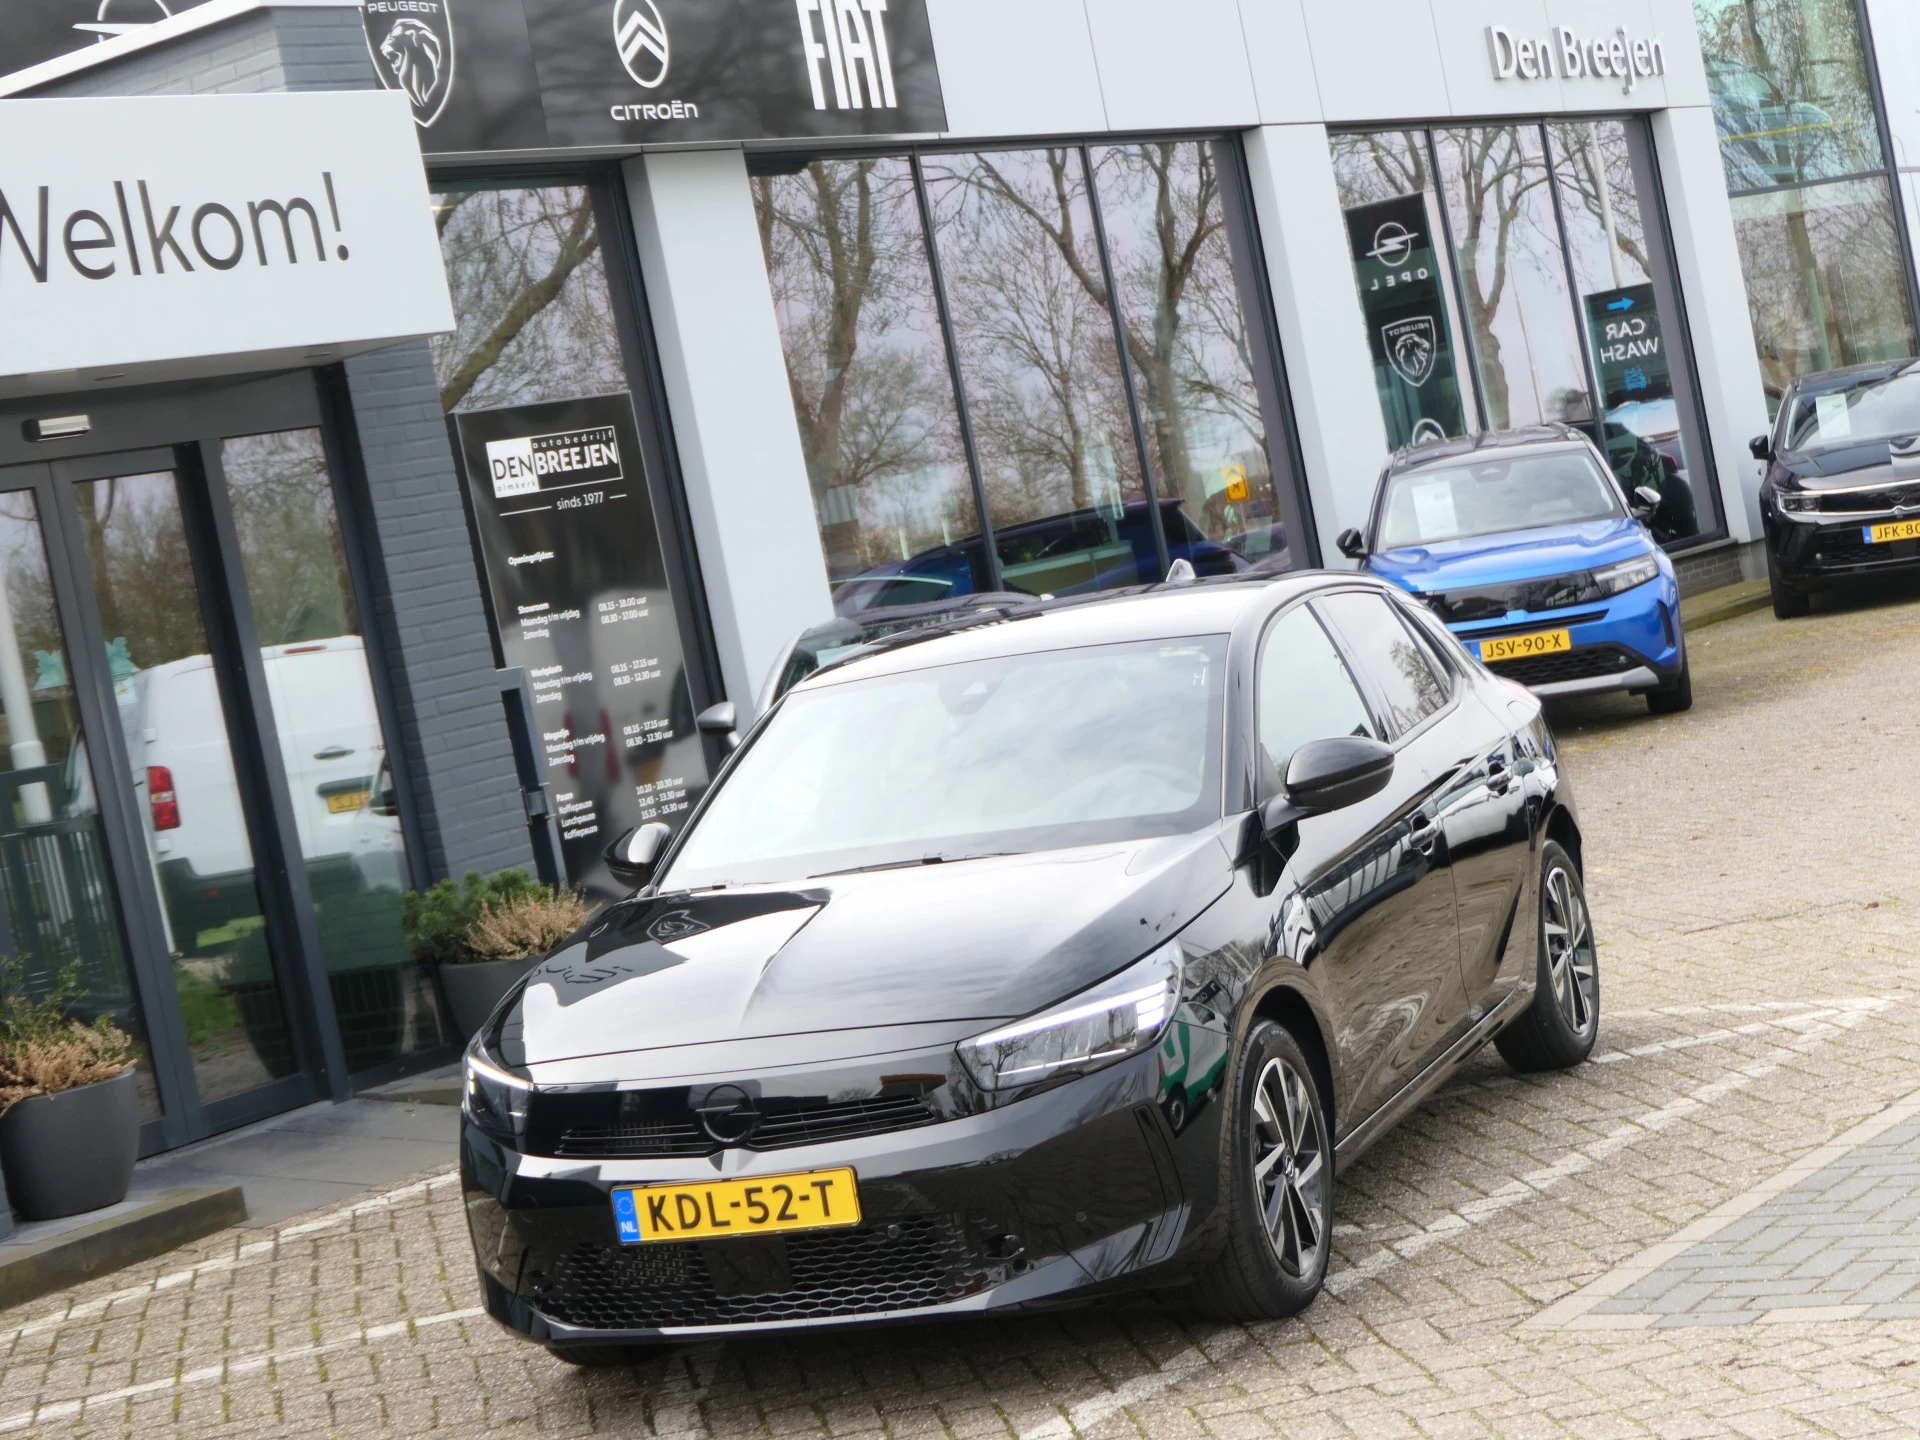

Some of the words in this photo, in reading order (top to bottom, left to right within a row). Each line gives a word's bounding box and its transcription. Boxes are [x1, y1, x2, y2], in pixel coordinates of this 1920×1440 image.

[367, 1, 438, 14] PEUGEOT
[796, 0, 897, 110] FIAT
[1484, 25, 1555, 80] Den
[1552, 25, 1667, 95] Breejen
[532, 429, 613, 449] autobedrijf
[492, 454, 534, 480] DEN
[534, 442, 618, 476] BREEJEN
[496, 479, 537, 493] almkerk
[556, 497, 582, 510] sinds
[582, 491, 604, 506] 1977
[1487, 633, 1561, 658] JSV-90-X
[647, 1180, 834, 1232] KDL-52-T
[621, 1221, 637, 1233] NL
